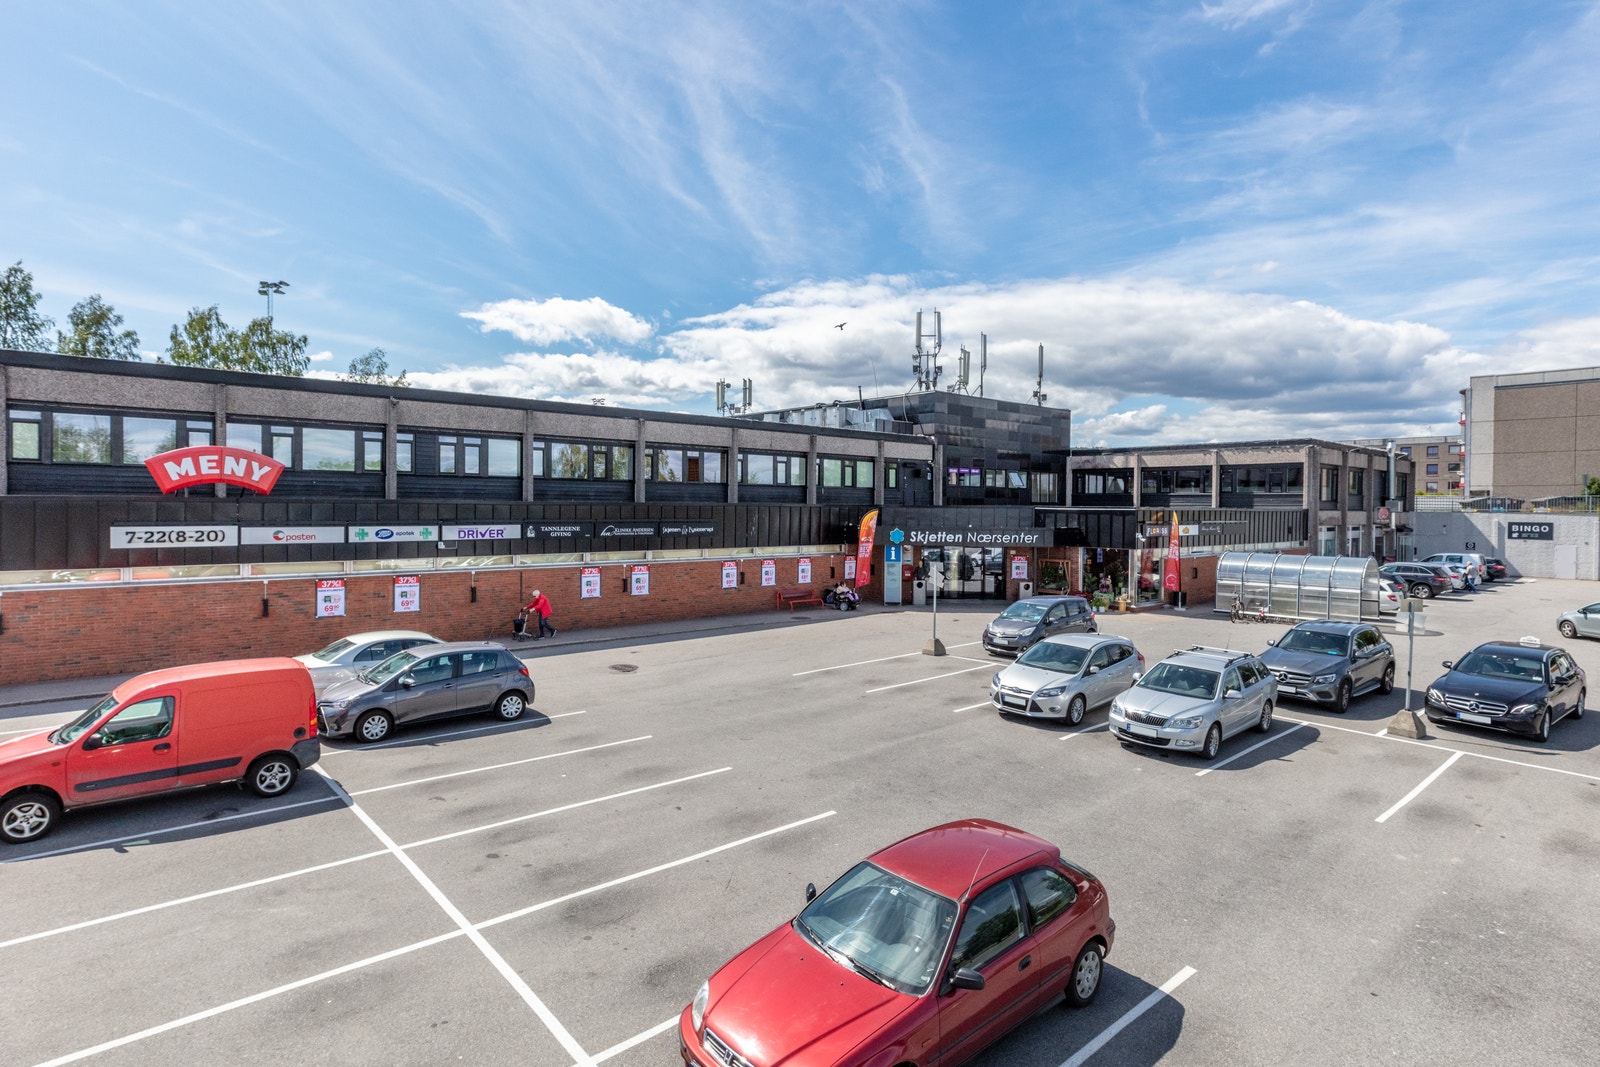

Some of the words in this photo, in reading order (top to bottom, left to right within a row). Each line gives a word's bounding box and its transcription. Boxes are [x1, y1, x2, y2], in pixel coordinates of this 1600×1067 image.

[164, 455, 272, 481] MENY
[457, 527, 505, 539] DRIVER
[1511, 524, 1549, 533] BINGO
[125, 530, 226, 544] 7-22(8-20)
[285, 533, 316, 542] posten
[909, 531, 963, 544] Skjetten
[967, 532, 1038, 544] Nærsenter
